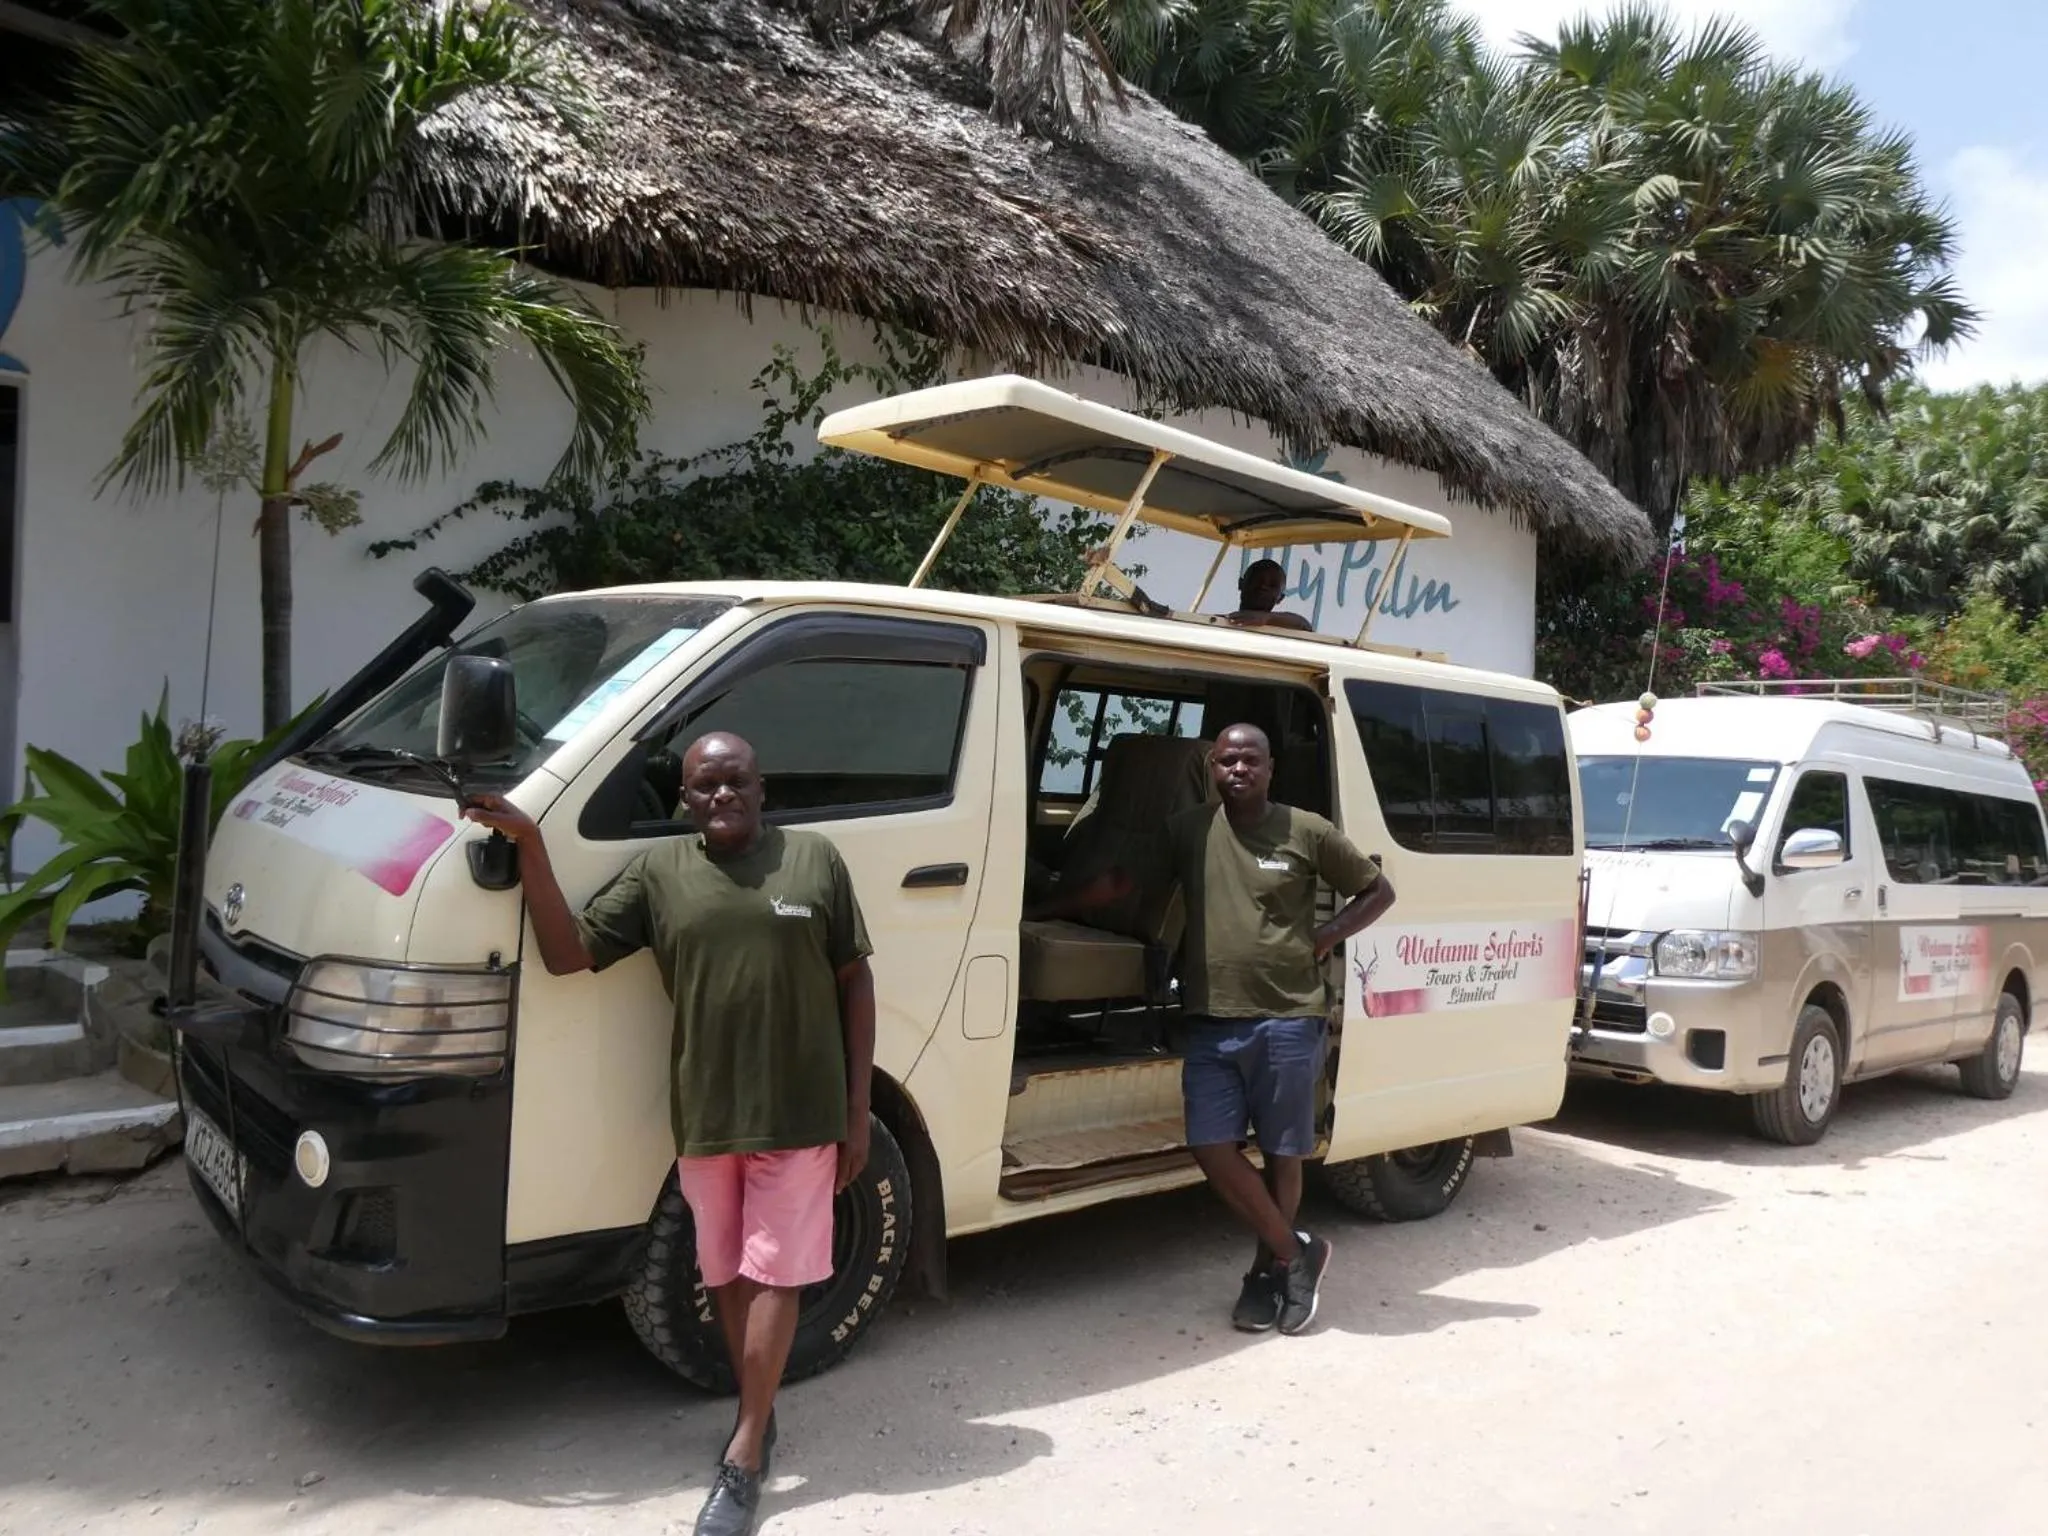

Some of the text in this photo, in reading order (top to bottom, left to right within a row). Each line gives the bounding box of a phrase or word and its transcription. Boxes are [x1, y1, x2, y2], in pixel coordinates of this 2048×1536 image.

[1337, 541, 1461, 619] Palm
[1396, 929, 1544, 967] Watamu Safaris
[1426, 962, 1519, 986] Tours & Travel
[1446, 983, 1498, 1005] Limited
[831, 1177, 898, 1343] BLACK BEAR
